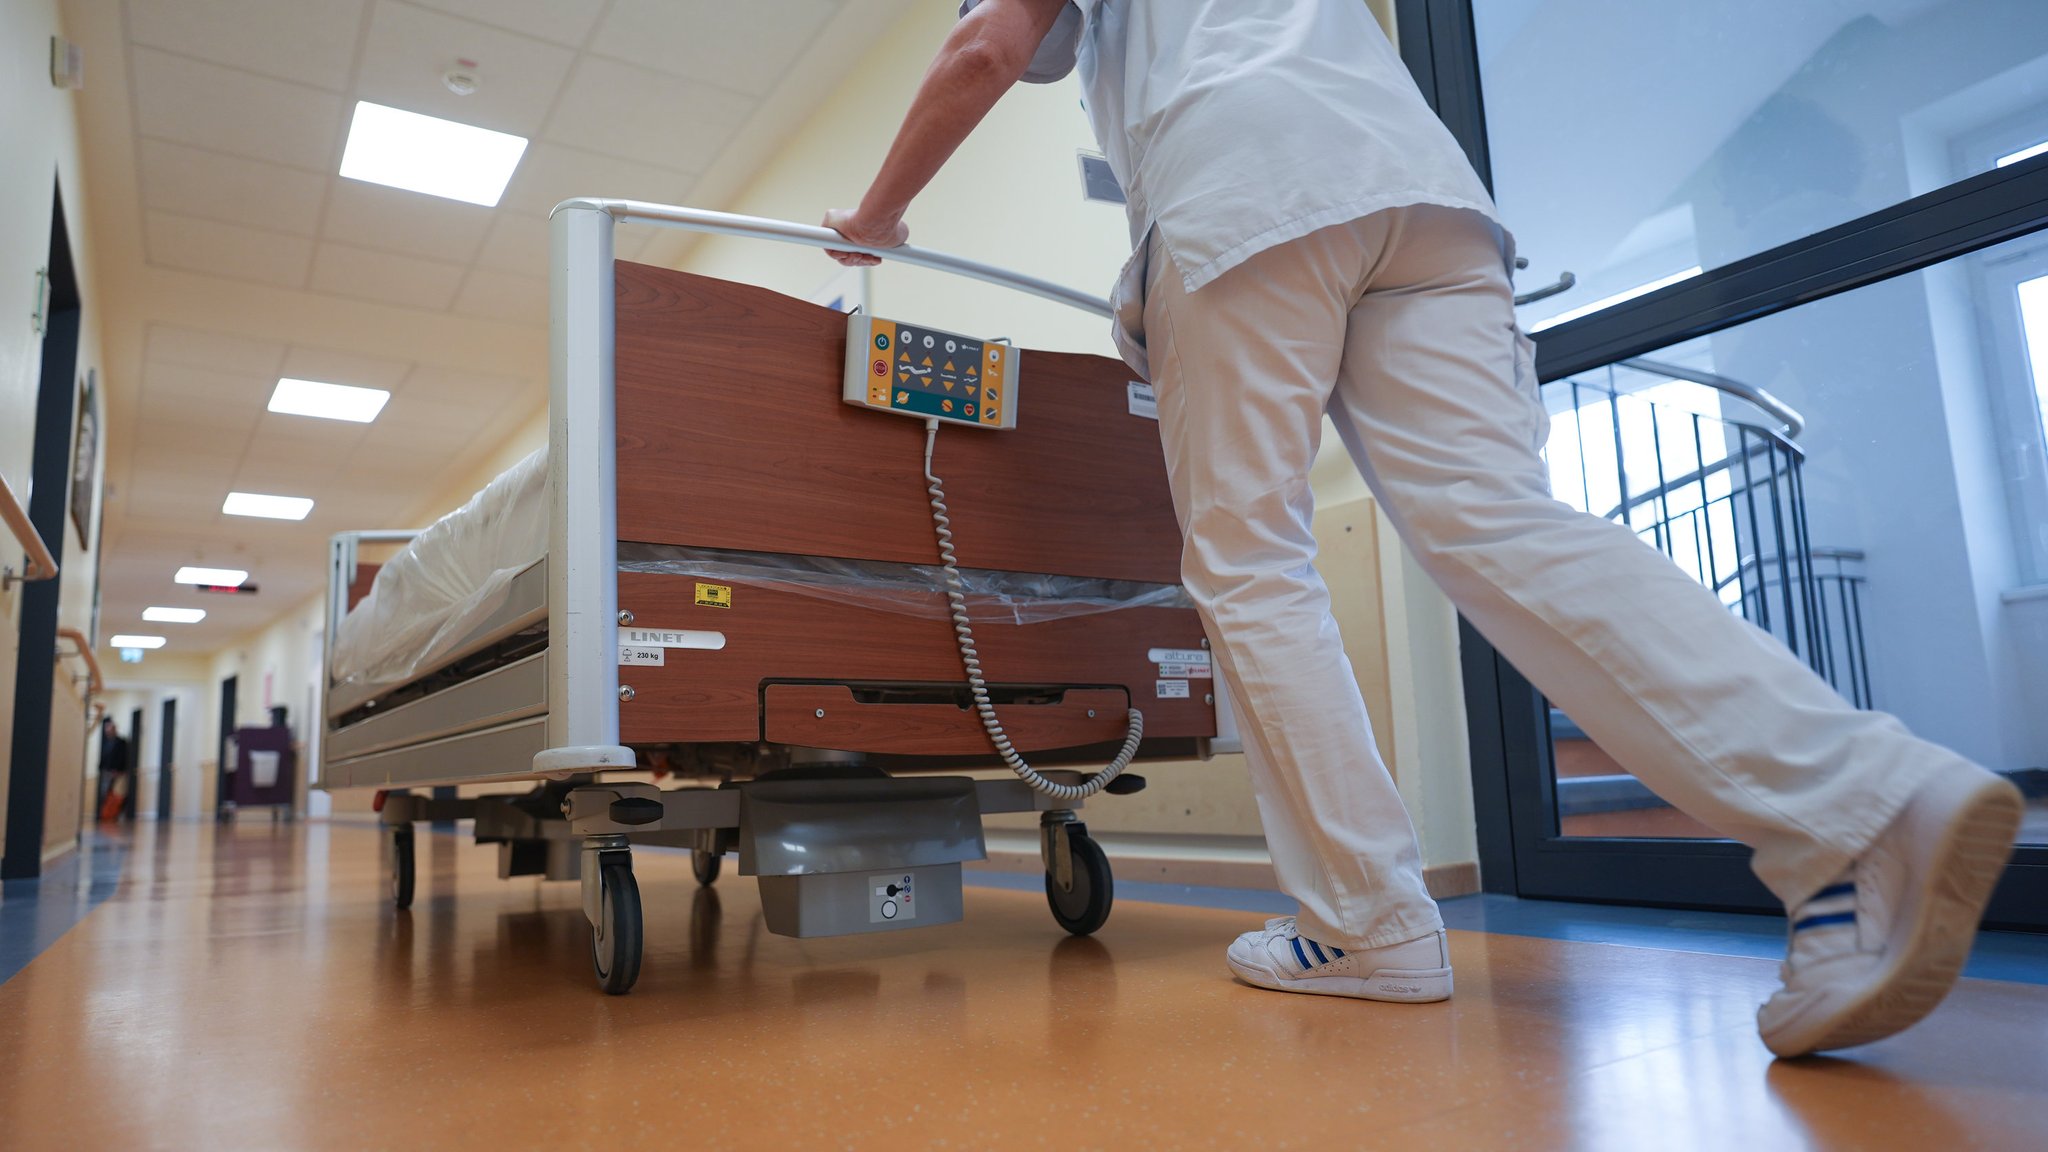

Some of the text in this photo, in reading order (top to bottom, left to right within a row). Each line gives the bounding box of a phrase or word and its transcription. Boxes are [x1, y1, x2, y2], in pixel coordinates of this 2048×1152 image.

[630, 631, 685, 644] LINET
[650, 652, 659, 660] kg
[1379, 983, 1409, 993] adidas
